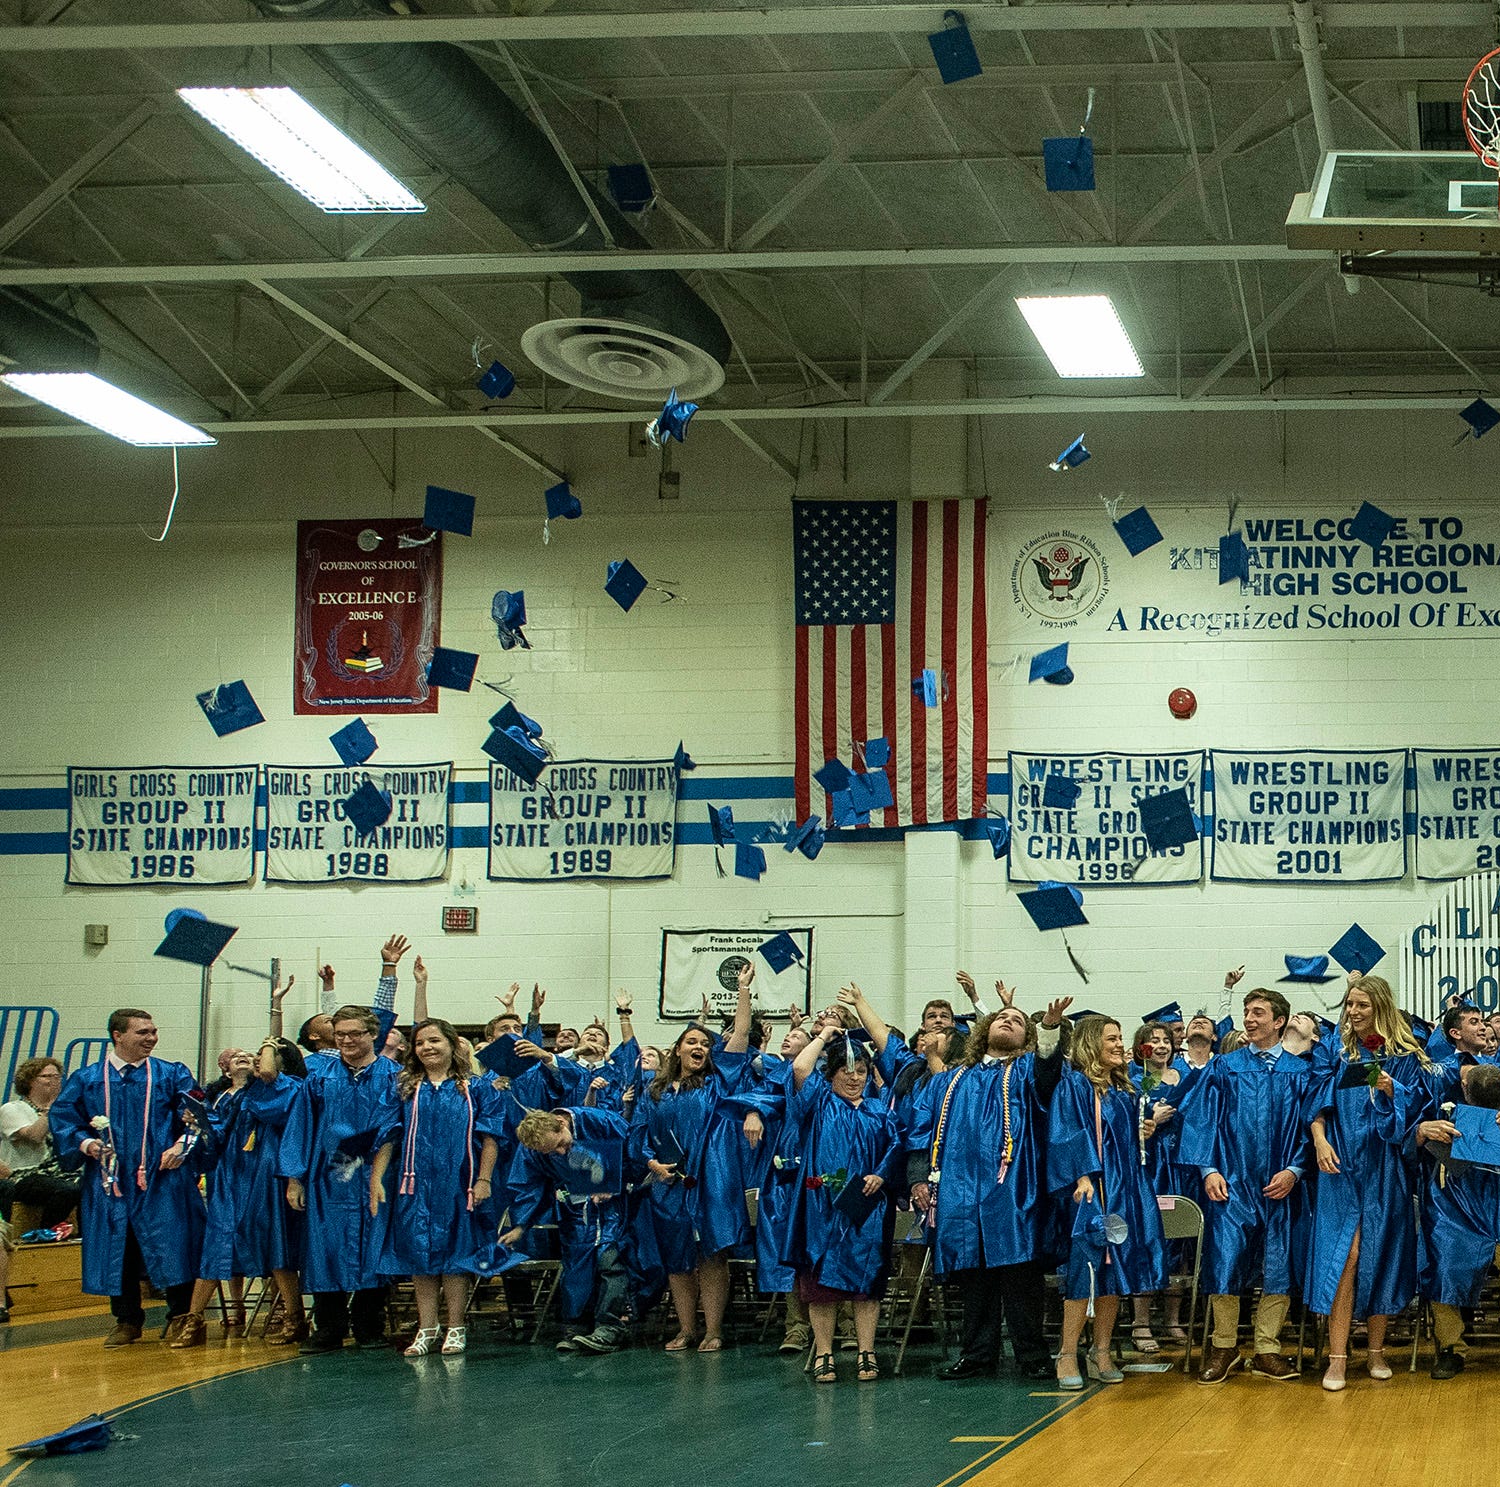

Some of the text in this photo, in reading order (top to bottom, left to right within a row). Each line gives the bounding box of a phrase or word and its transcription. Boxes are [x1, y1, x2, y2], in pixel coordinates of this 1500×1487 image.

[1024, 531, 1060, 550] Education
[1062, 530, 1078, 539] Blue
[1245, 517, 1462, 542] WELCOE TO
[1019, 550, 1026, 558] of
[1080, 535, 1102, 556] Ribbon
[1169, 545, 1360, 570] KITATINNY
[320, 560, 418, 571] GOVERNOR'S SCHOOL
[1101, 556, 1110, 587] Schools
[362, 577, 374, 586] OF
[1011, 559, 1021, 604] Department
[1240, 571, 1467, 596] HIGH SCHOOL
[1086, 588, 1109, 616] Program
[348, 611, 384, 621] 2005-06
[1040, 620, 1078, 629] 1997-1998
[1106, 607, 1128, 631] A
[1139, 604, 1299, 637] Recognized
[1307, 603, 1400, 629] School
[1409, 602, 1450, 628] Of
[550, 767, 598, 790] CROSS
[609, 766, 676, 791] COUNTRY
[1028, 758, 1188, 782] WRESTLING
[1230, 761, 1388, 785] WRESTLING
[74, 772, 253, 798] GIRLS CROSS COUNTRY
[270, 772, 312, 796] GIRLS
[384, 770, 446, 795] COUNTRY
[522, 794, 647, 820] GROUP II
[1094, 786, 1112, 808] II
[1250, 792, 1369, 814] GROUP II
[102, 800, 225, 825] GROUP II
[398, 800, 420, 822] II
[1017, 810, 1078, 834] STATE
[72, 826, 250, 852] STATE CHAMPIONS
[270, 824, 444, 850] STATE CHAMPIONS
[493, 822, 672, 847] STATE CHAMPIONS
[1217, 818, 1400, 845] STATE CHAMPIONS
[1420, 816, 1479, 840] STATE
[130, 854, 194, 878] 1986
[326, 852, 388, 876] 1988
[550, 850, 612, 874] 1989
[1078, 862, 1133, 881] 1996
[1277, 850, 1342, 874] 2001
[711, 992, 758, 1000] 2013-14
